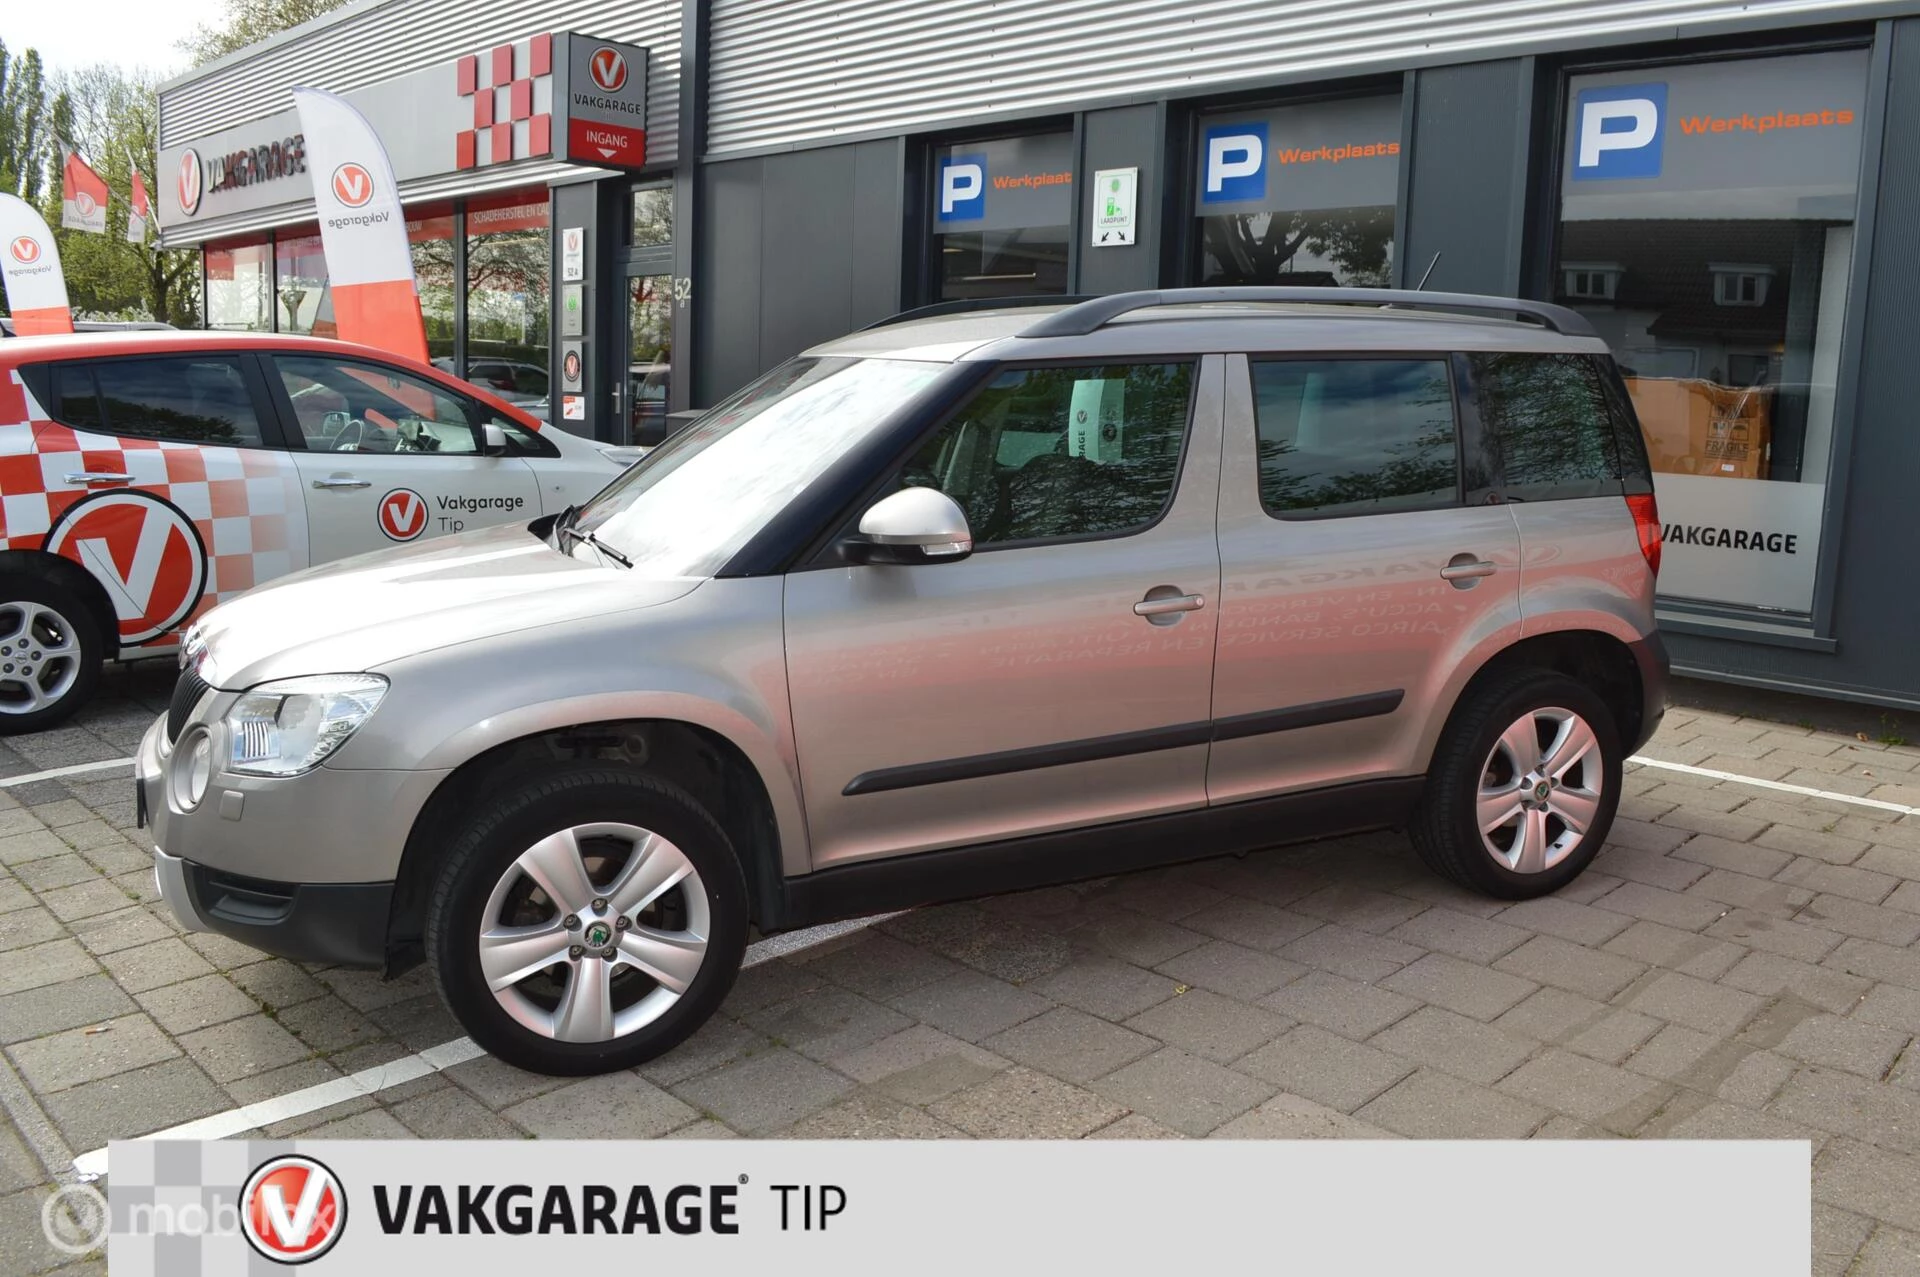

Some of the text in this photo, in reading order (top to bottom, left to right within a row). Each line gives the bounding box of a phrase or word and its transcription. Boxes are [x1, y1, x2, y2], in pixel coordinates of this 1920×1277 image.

[574, 93, 641, 115] VAKGARAGE
[586, 130, 628, 148] INGANG
[1579, 99, 1854, 167] P Werkplaats
[207, 134, 306, 194] VAKGARAGE
[1207, 134, 1400, 192] P Werkplaats
[942, 163, 1073, 213] P Werkplaat
[1101, 216, 1127, 225] LAADPUNT
[675, 278, 692, 300] 52
[1706, 440, 1749, 453] FRAGILE
[436, 495, 524, 513] Vakgarage
[437, 517, 464, 534] Tip
